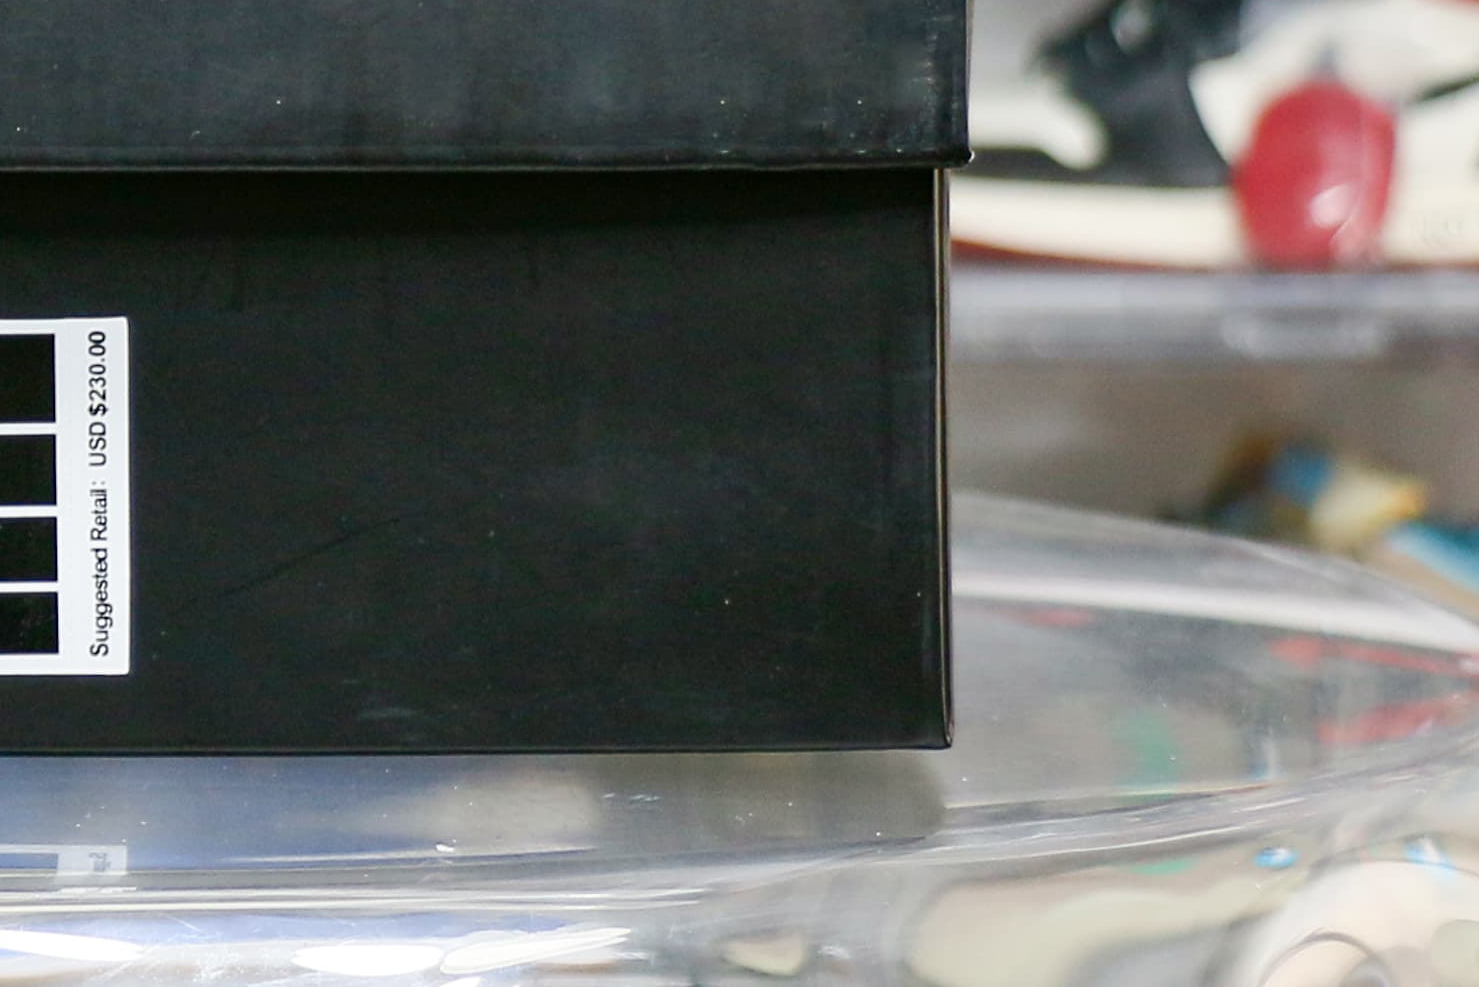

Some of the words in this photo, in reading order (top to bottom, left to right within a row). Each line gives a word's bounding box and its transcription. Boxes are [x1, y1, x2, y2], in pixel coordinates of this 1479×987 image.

[87, 330, 108, 416] $230.00
[88, 421, 107, 467] USD
[89, 548, 114, 656] Suggested
